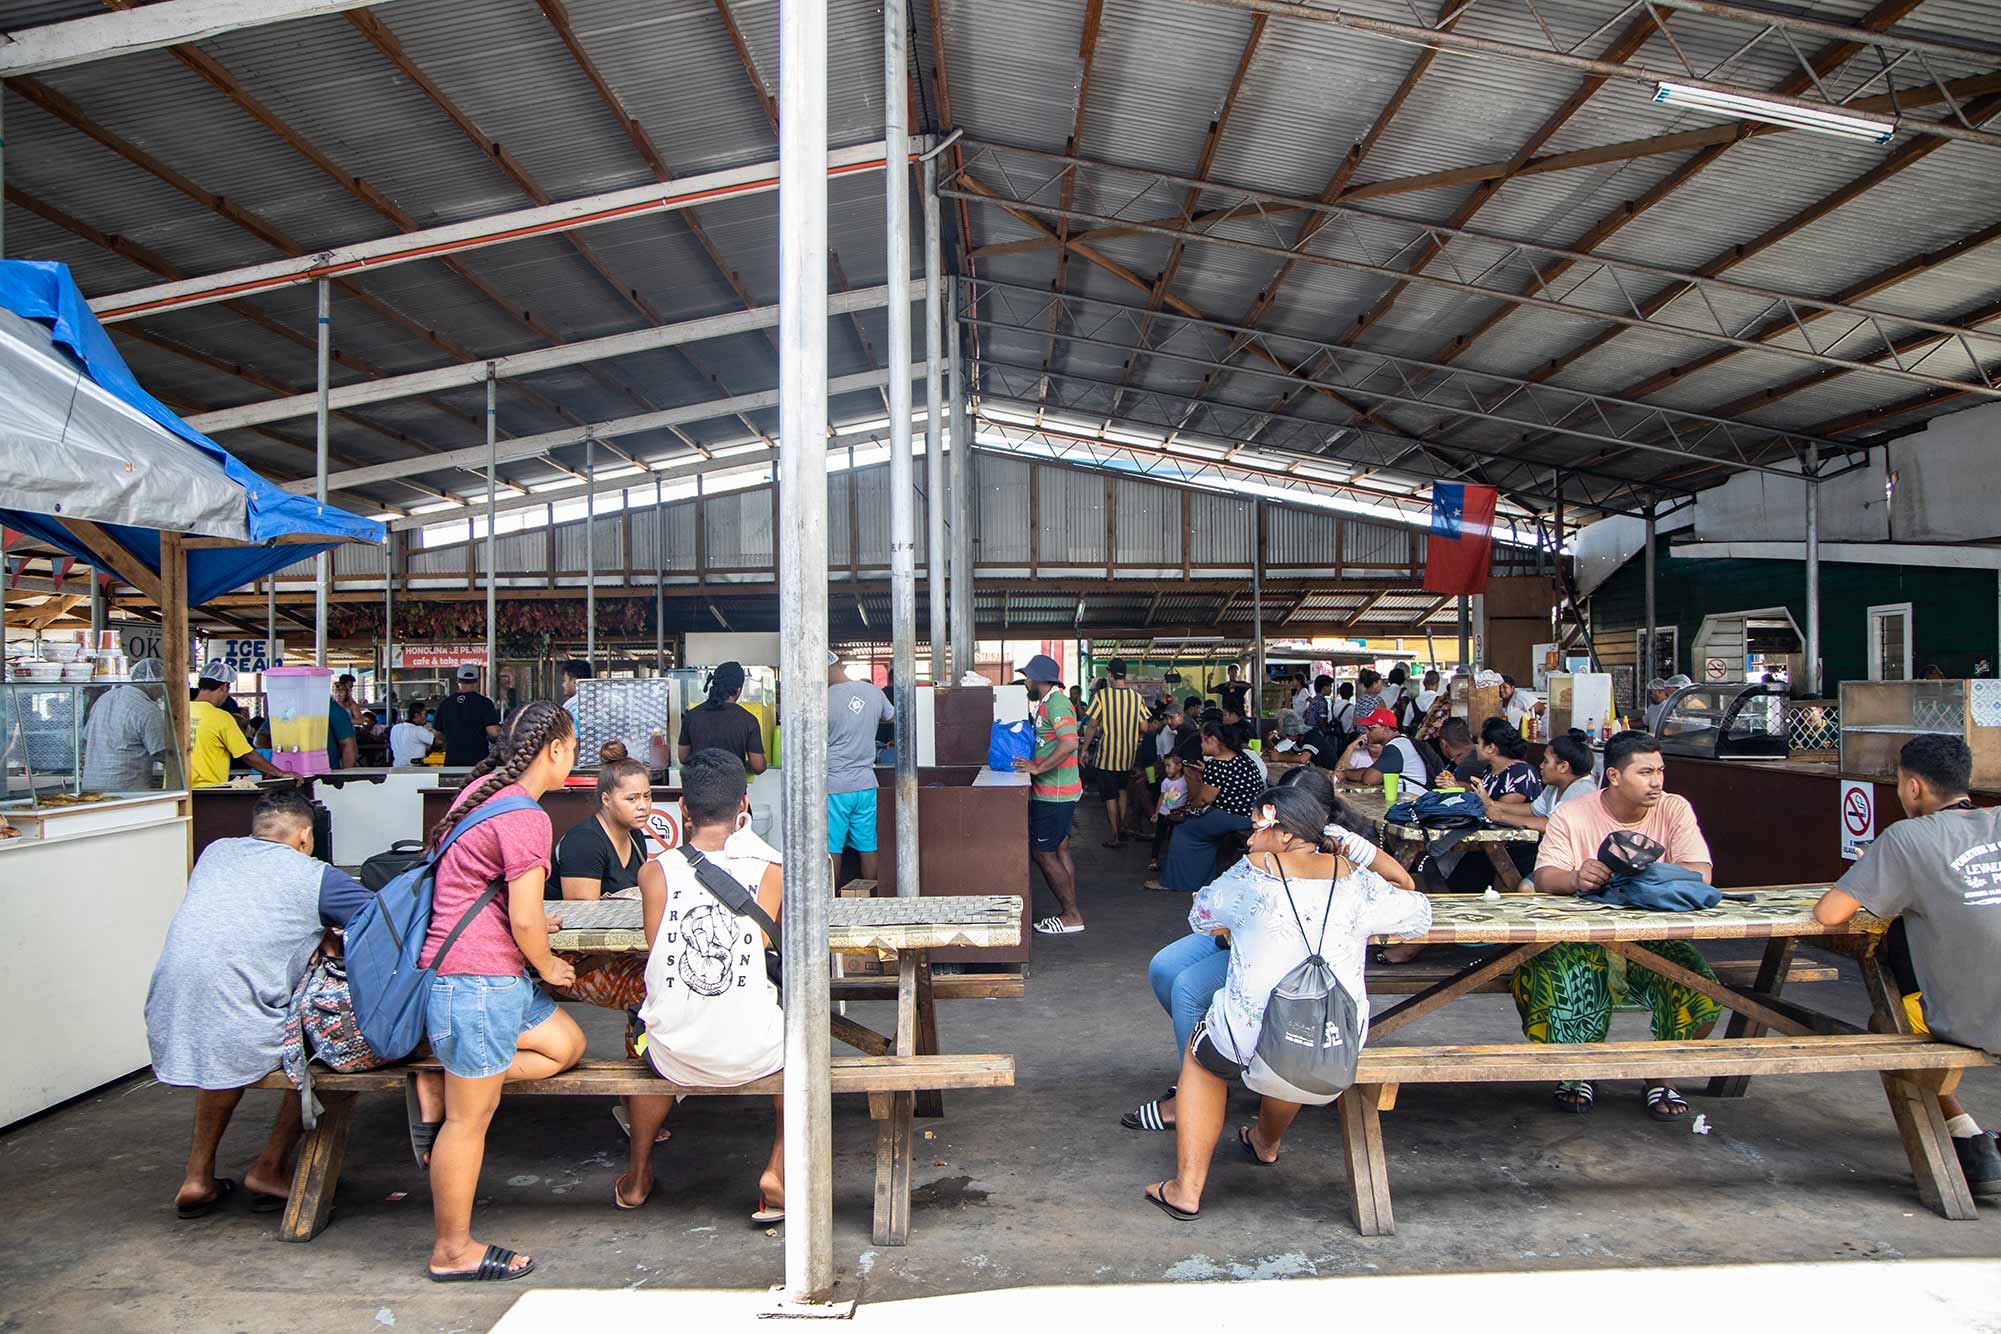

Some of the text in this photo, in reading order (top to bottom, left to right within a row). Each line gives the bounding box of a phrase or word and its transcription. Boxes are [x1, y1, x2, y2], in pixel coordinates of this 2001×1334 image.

[226, 640, 266, 657] ICE
[412, 656, 483, 666] cafe & take away
